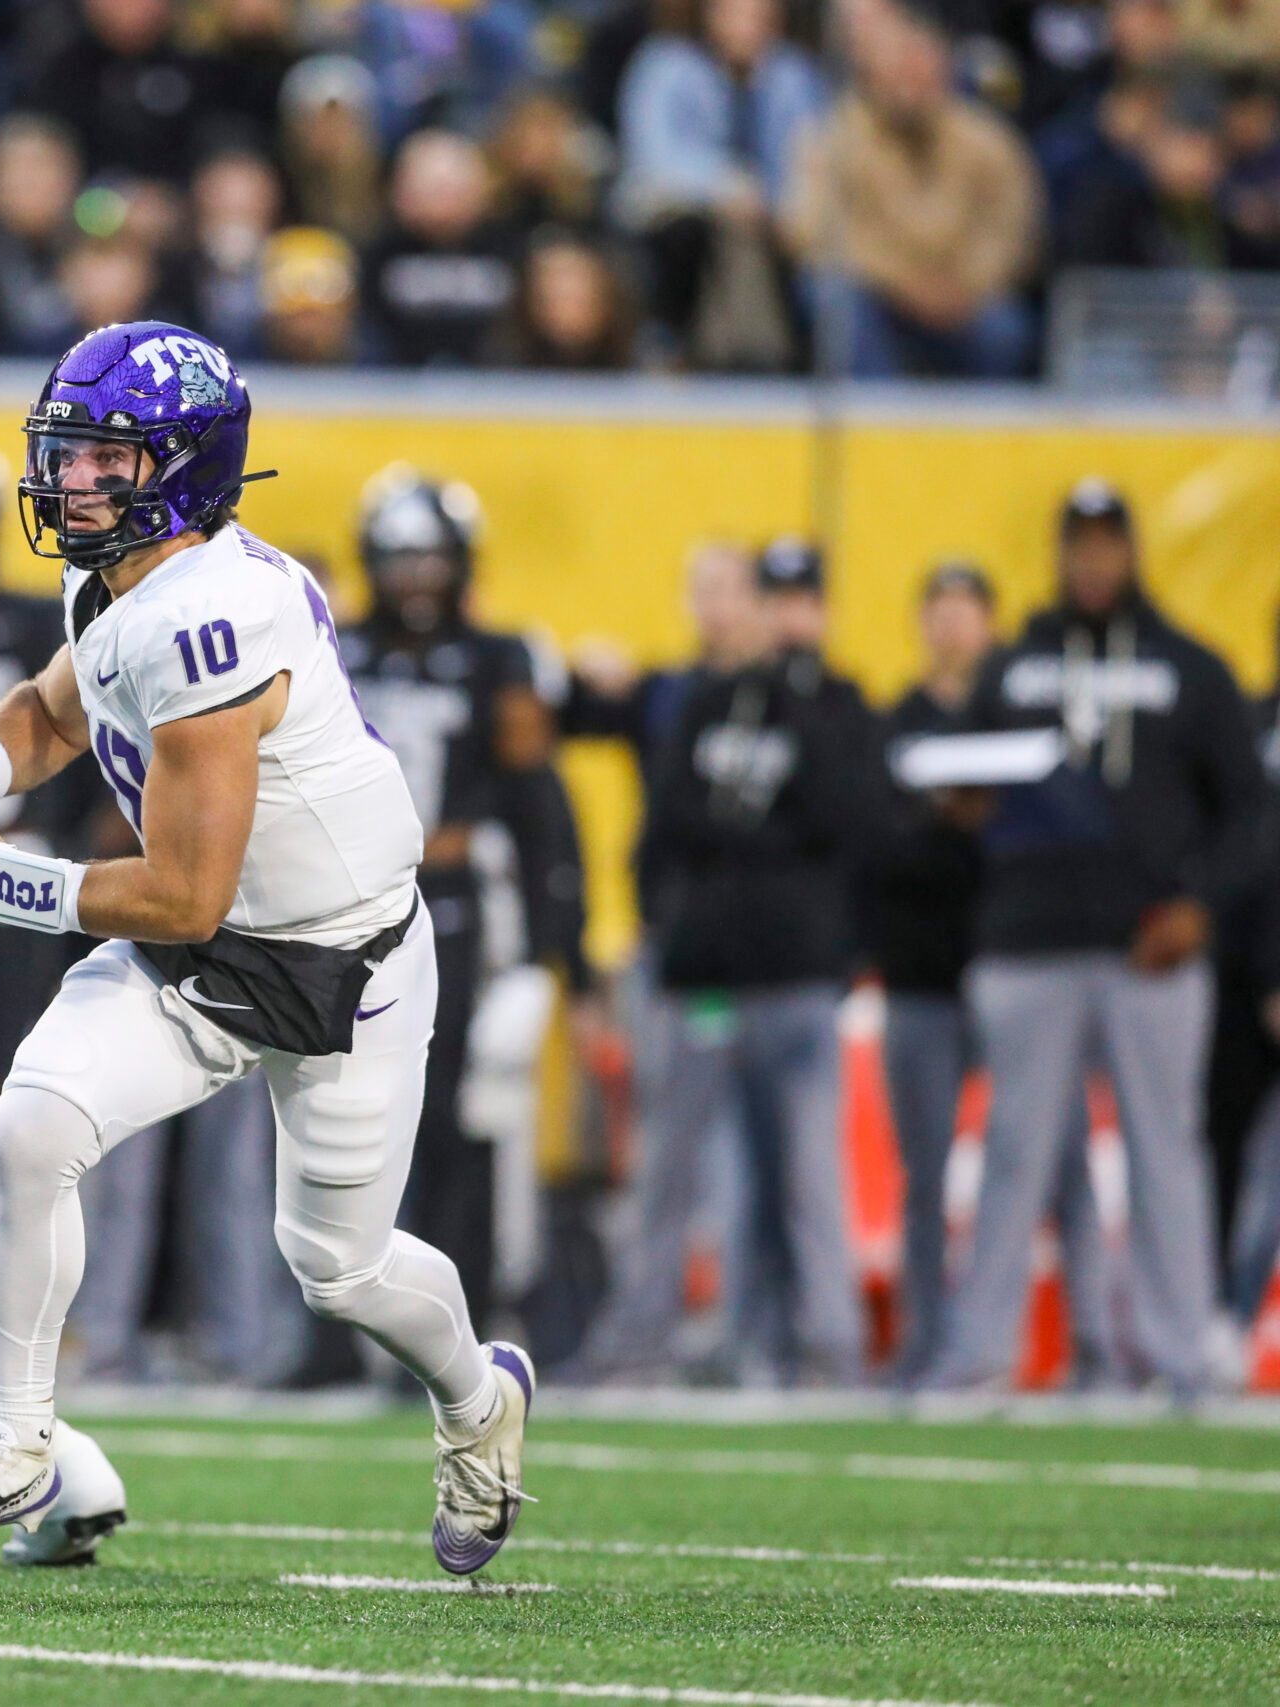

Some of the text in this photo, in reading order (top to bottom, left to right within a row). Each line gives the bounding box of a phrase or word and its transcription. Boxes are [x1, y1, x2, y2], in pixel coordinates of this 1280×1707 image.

[130, 335, 231, 387] TCU
[46, 401, 72, 418] TCU
[171, 618, 239, 687] 10
